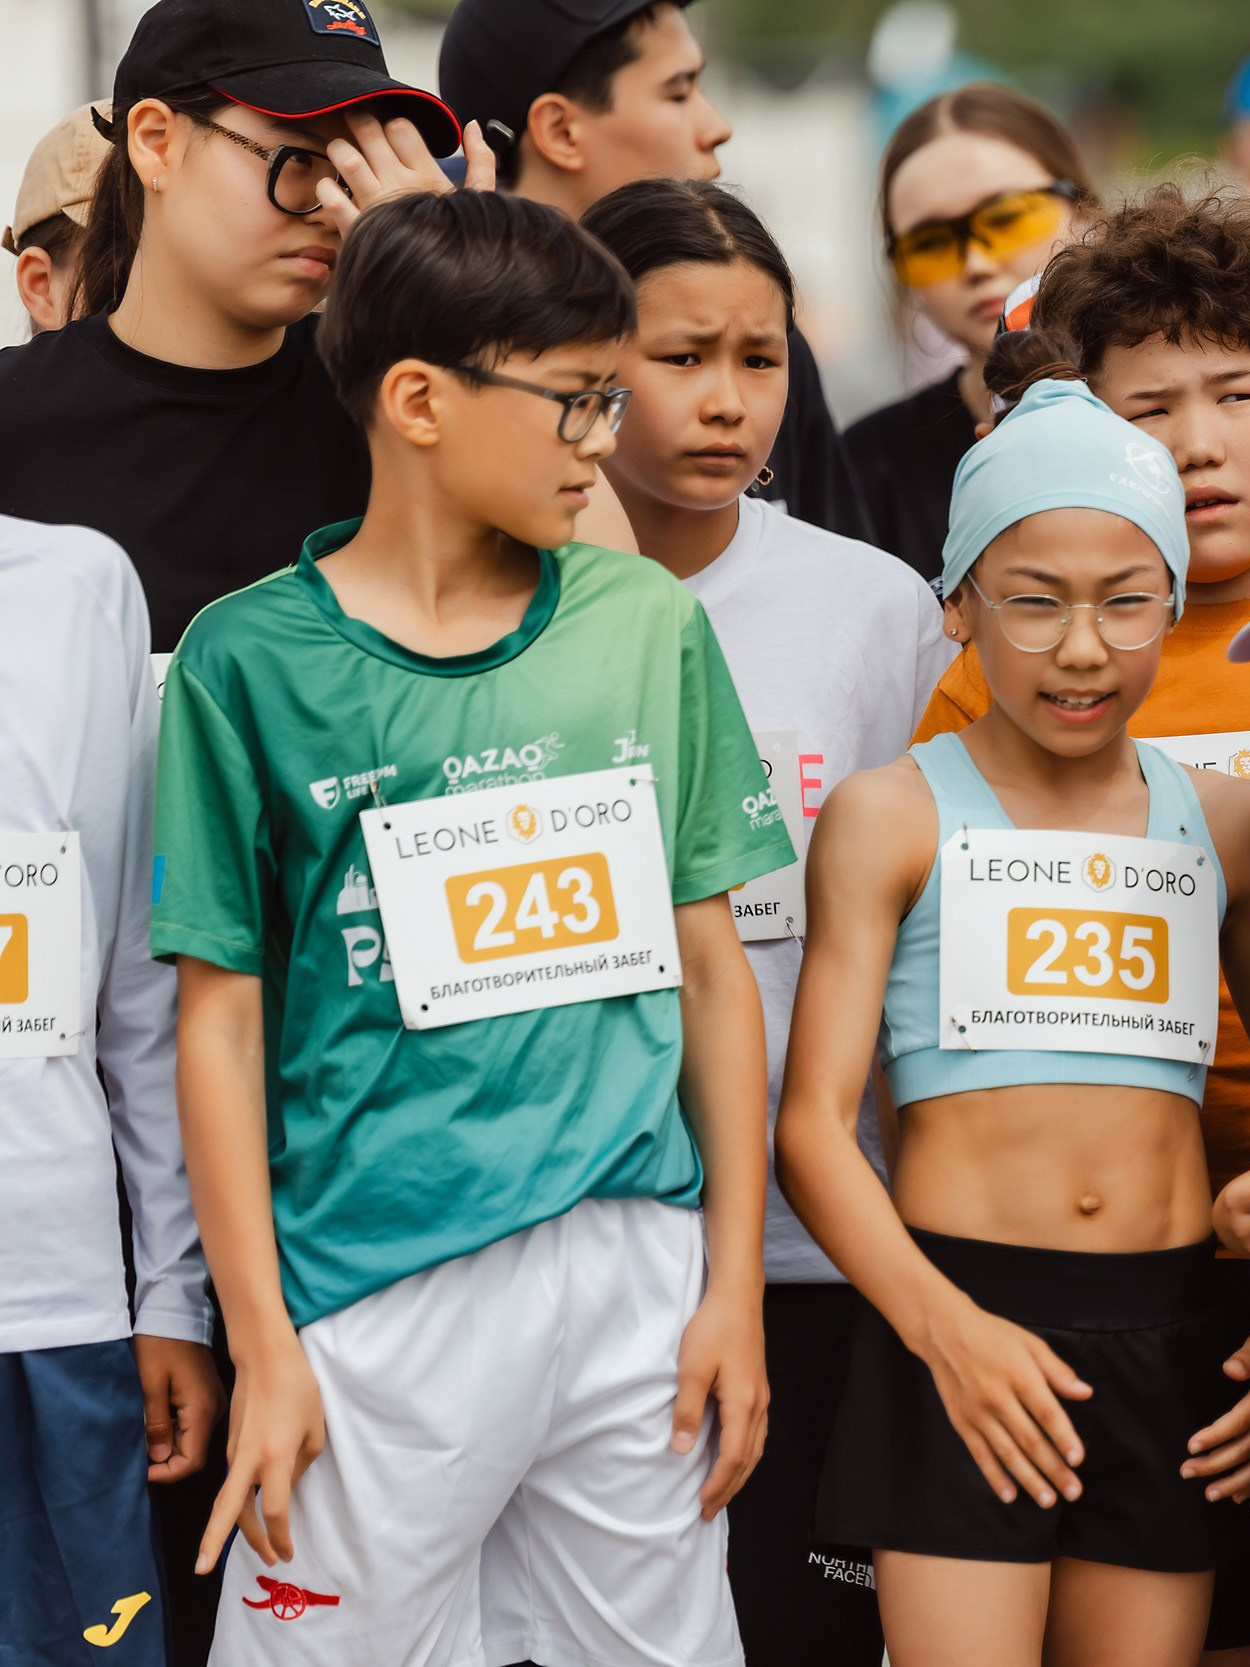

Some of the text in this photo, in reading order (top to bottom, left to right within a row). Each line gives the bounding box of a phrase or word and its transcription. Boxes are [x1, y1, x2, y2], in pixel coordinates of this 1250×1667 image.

[442, 744, 542, 784] QAZAQ
[742, 789, 777, 818] QAZ
[396, 799, 632, 859] LEONE D'ORO
[970, 859, 1196, 896] LEONE D'ORO
[465, 866, 601, 951] 243
[734, 902, 781, 918] ЗАБЕГ
[1024, 919, 1156, 991] 235
[430, 954, 609, 1000] БЛАГОТВОРИТЕЛЬНЫЙ
[612, 950, 653, 969] ЗАБЕГ
[17, 1017, 56, 1033] ЗАБЕГ
[971, 1010, 1196, 1036] БЛАГОТВОРИТЕЛЬНЫЙ ЗАБЕГ
[824, 1566, 864, 1586] FACE
